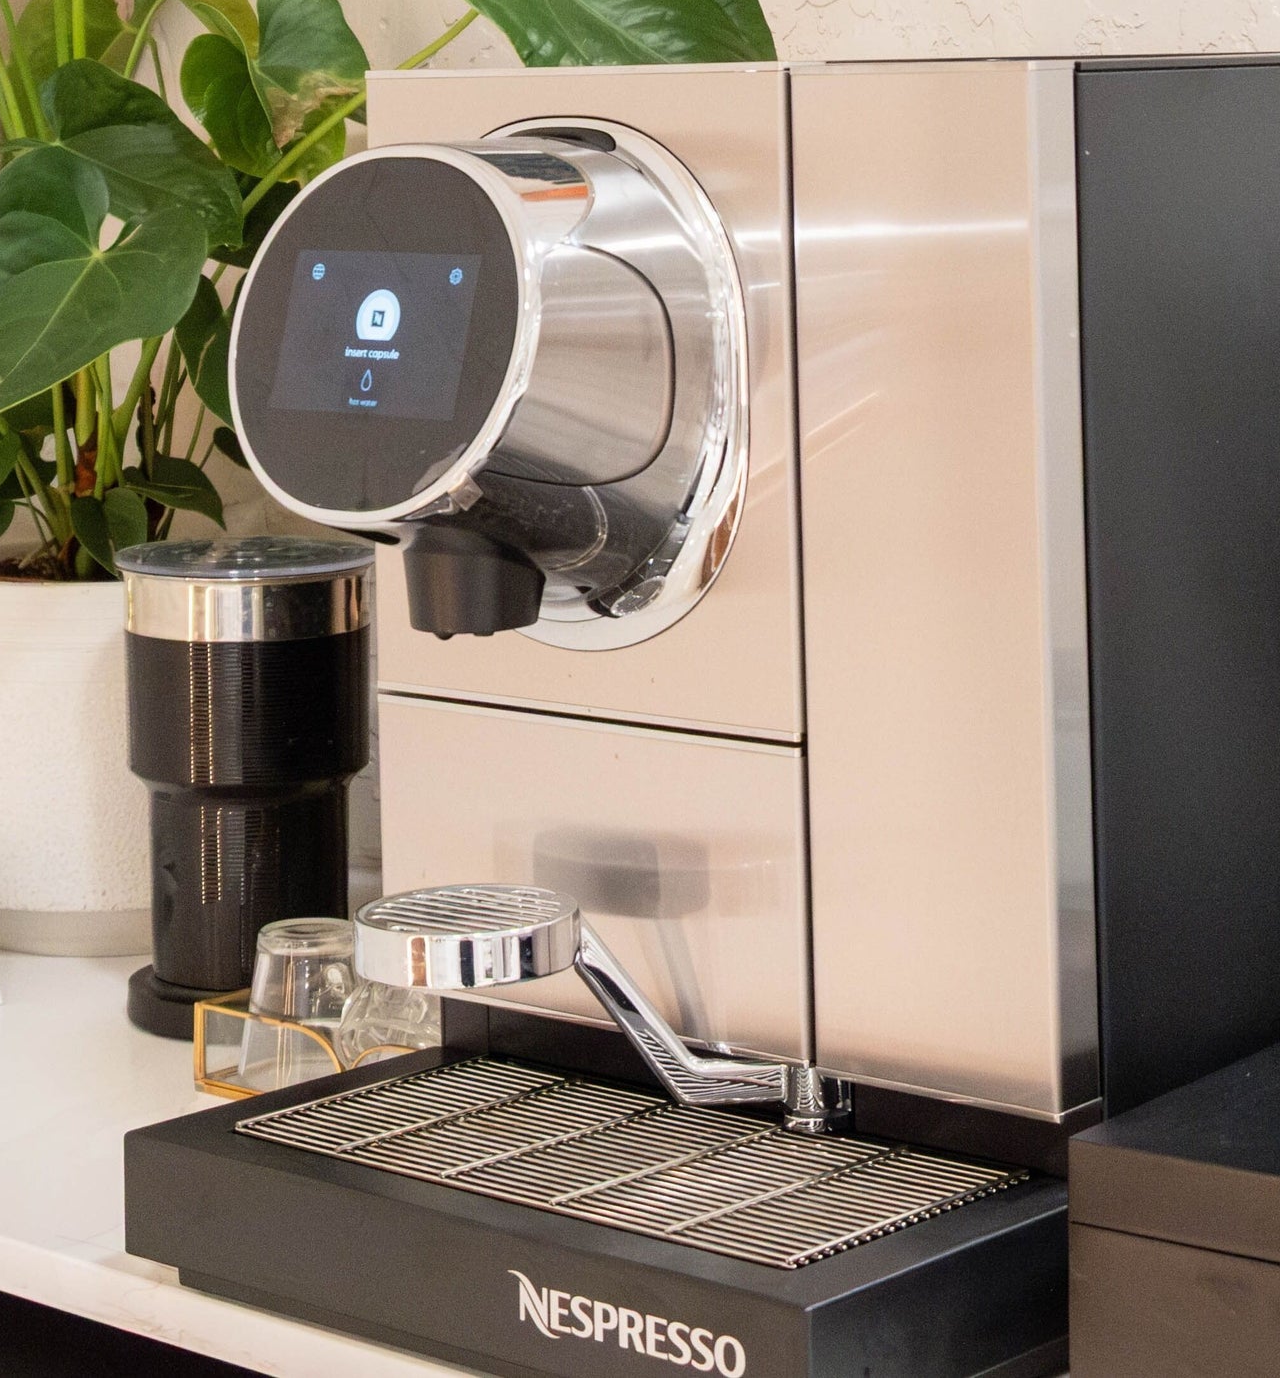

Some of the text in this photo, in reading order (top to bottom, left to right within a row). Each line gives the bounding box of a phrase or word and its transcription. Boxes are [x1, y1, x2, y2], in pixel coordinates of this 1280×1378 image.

[344, 345, 400, 360] insert capsule
[507, 1269, 746, 1377] NESPRESSO
